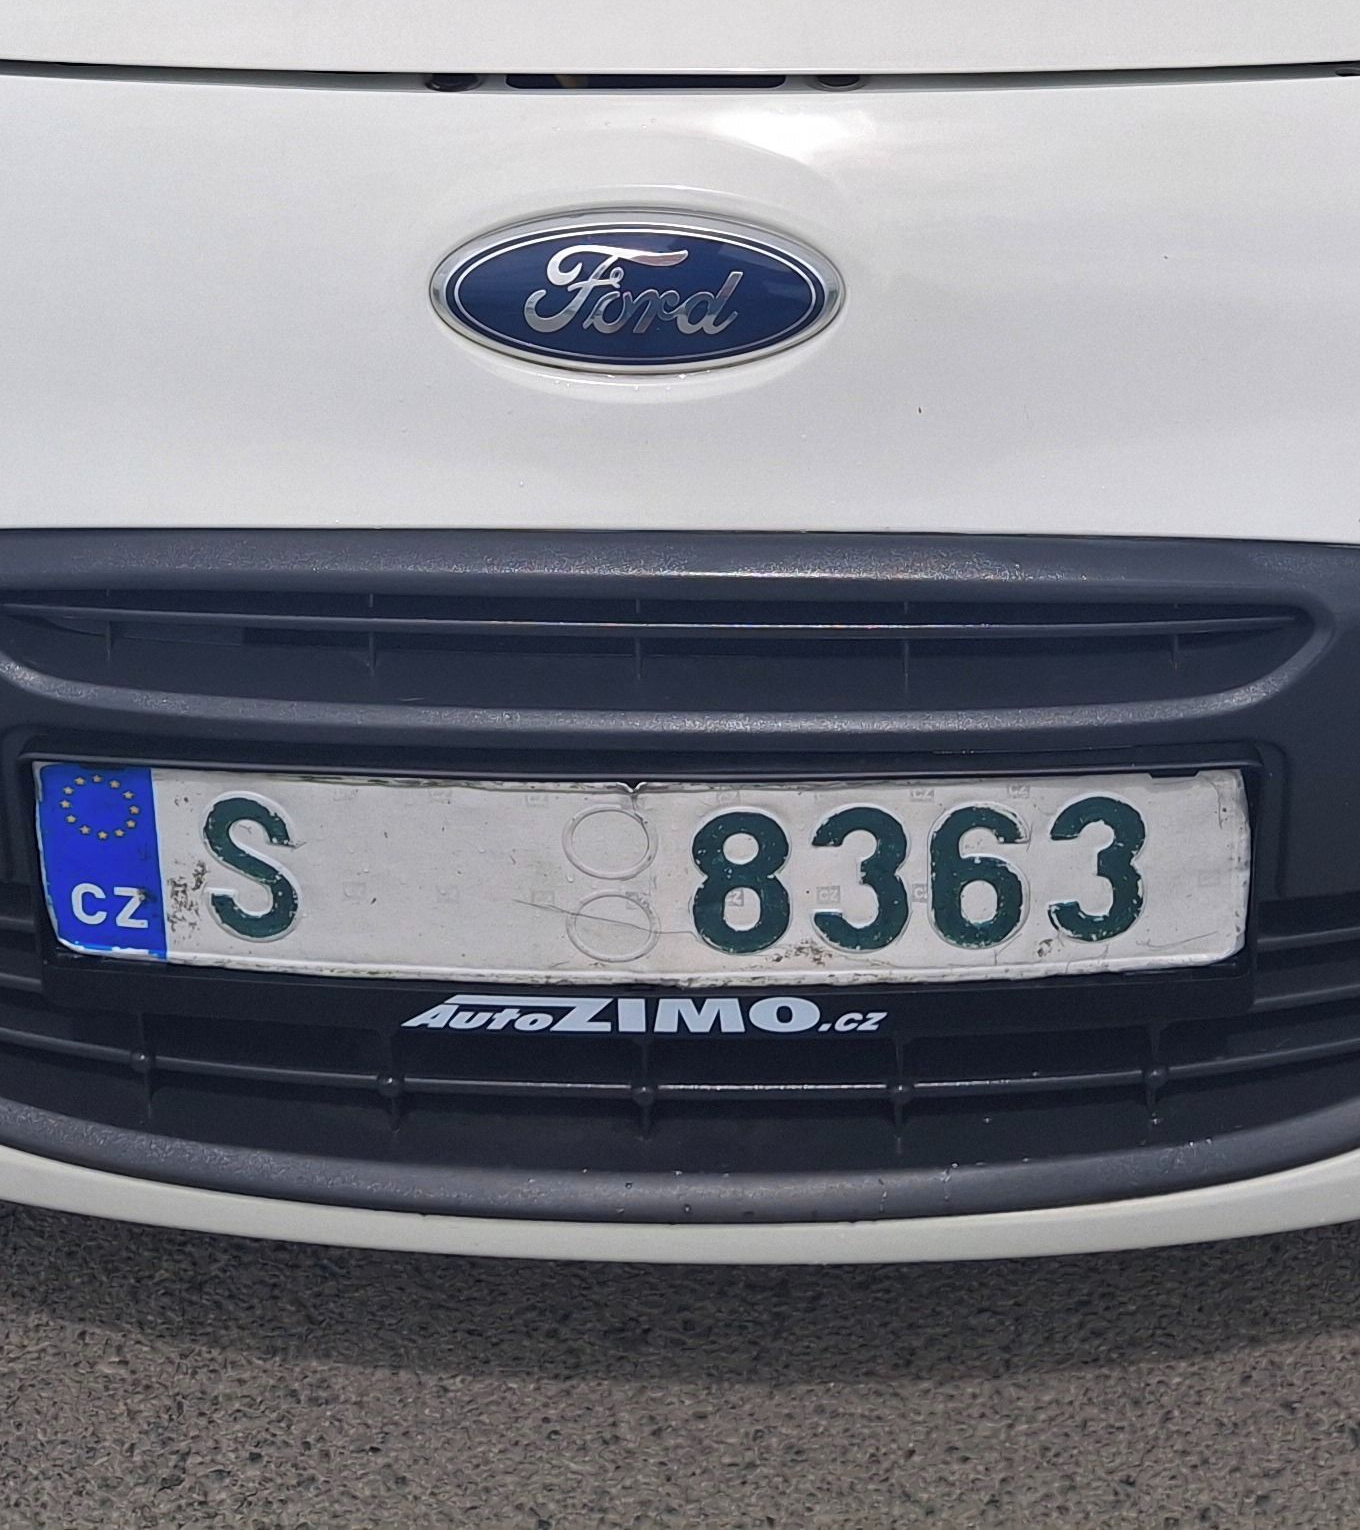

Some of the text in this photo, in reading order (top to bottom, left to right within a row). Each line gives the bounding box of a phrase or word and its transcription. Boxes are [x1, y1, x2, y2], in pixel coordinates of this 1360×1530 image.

[523, 244, 744, 335] Ford
[70, 882, 149, 929] CZ
[203, 795, 1147, 955] S 8363
